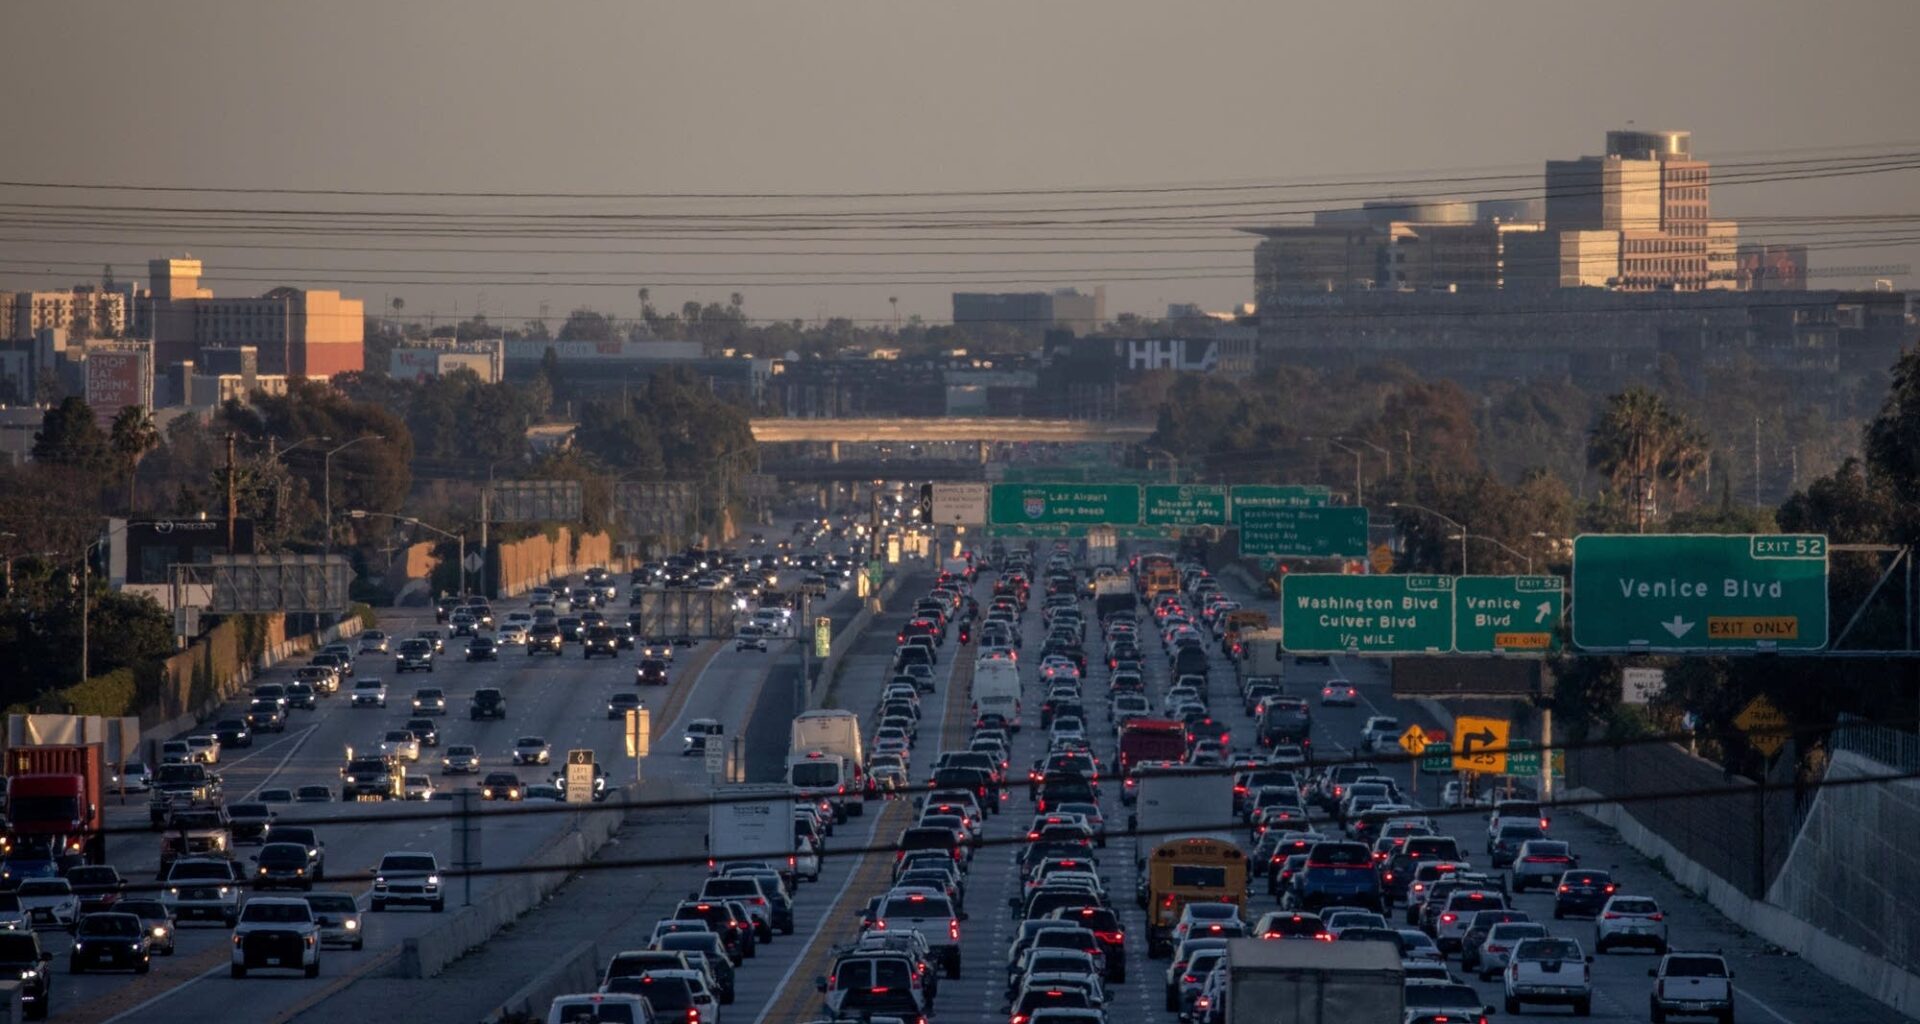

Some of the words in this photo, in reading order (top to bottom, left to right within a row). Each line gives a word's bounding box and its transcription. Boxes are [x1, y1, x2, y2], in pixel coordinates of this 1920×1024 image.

[1074, 493, 1107, 502] Airport
[1234, 497, 1287, 505] Washington
[1290, 496, 1310, 505] Blvd
[1027, 505, 1044, 514] 405
[1053, 507, 1075, 516] Long
[1078, 506, 1104, 515] Beach
[1151, 508, 1181, 516] Marina
[1202, 509, 1219, 517] Rey
[1244, 511, 1294, 519] Washington
[1244, 521, 1274, 530] Culver
[1757, 542, 1789, 552] EXIT
[1796, 540, 1821, 554] 52
[1438, 579, 1450, 588] 51
[1520, 580, 1539, 588] EXIT
[1544, 579, 1560, 588] 52
[1620, 578, 1708, 598] Venice
[1724, 579, 1782, 598] Blvd
[1298, 596, 1393, 611] Washington
[1402, 597, 1438, 609] Blvd
[1466, 597, 1521, 609] Venice
[1320, 615, 1374, 627] Culver
[1380, 616, 1417, 628] Blvd
[1475, 614, 1511, 627] Blvd
[1710, 623, 1743, 633] EXIT
[1753, 622, 1795, 634] ONLY
[1340, 633, 1358, 646] 1/2
[1363, 634, 1395, 645] MILE
[1497, 636, 1517, 645] EXIT
[1474, 754, 1496, 765] 25
